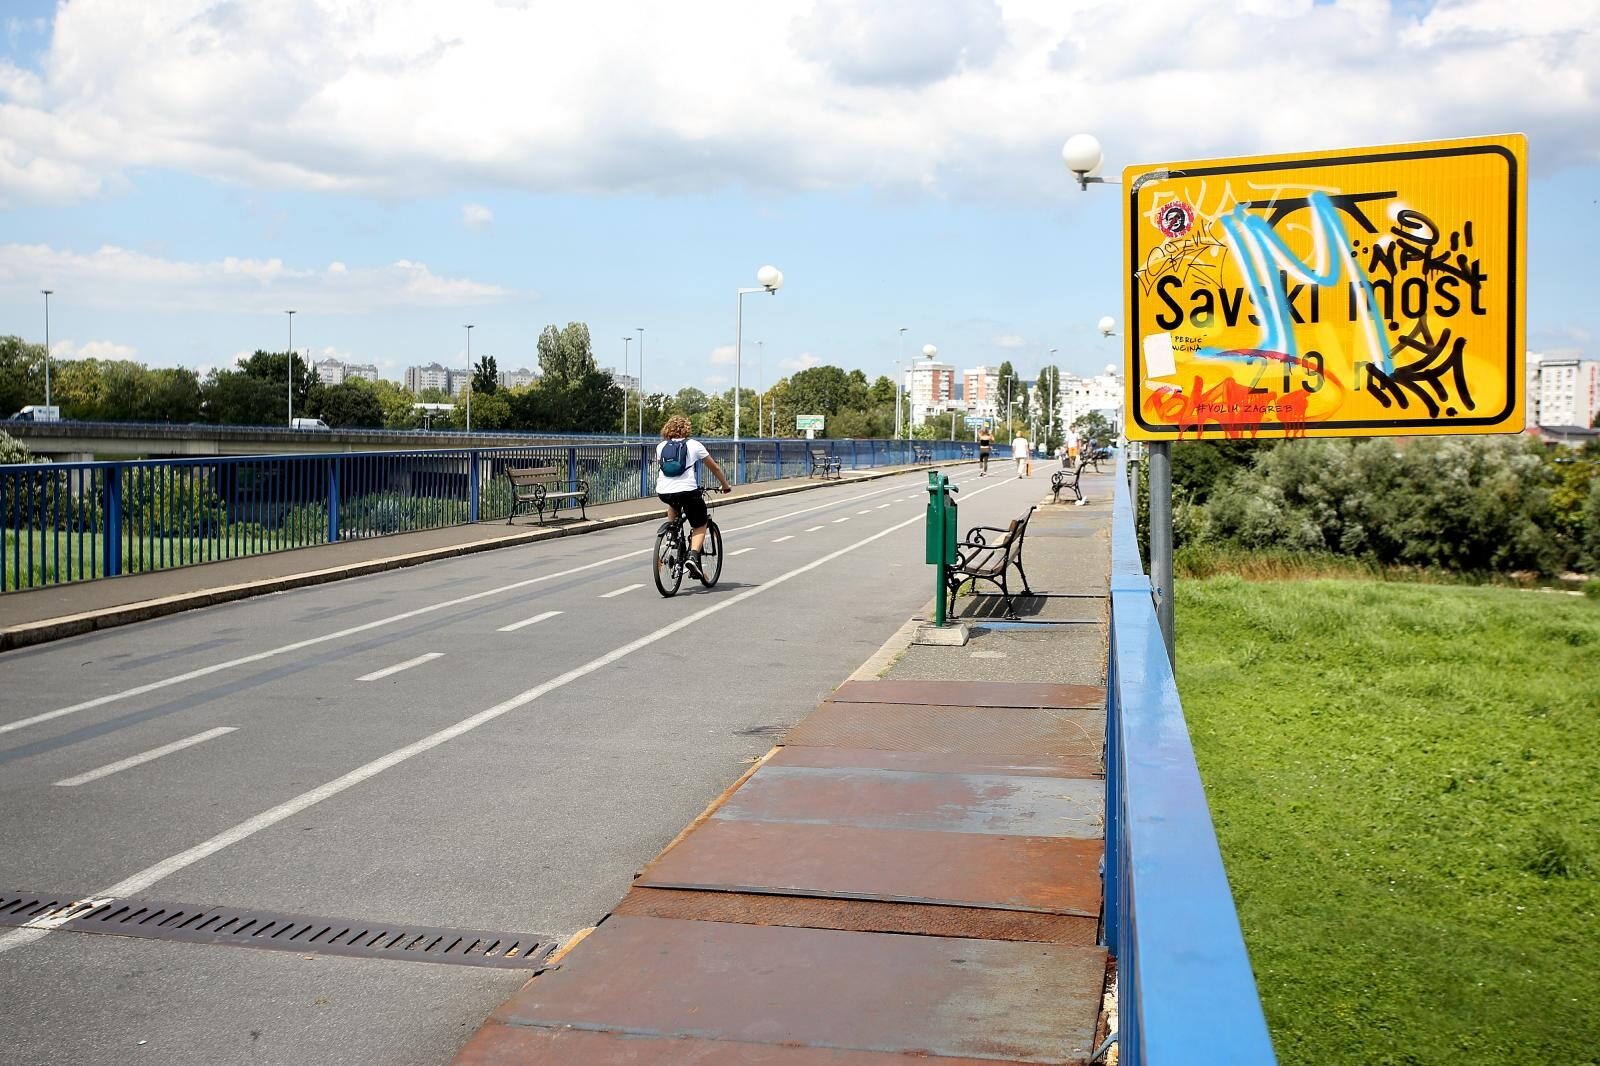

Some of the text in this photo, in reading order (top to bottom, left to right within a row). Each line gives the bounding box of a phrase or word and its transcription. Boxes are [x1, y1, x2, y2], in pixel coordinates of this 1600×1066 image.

[1349, 259, 1488, 321] most
[1246, 351, 1324, 393] 219
[1243, 404, 1293, 413] ZAGREB
